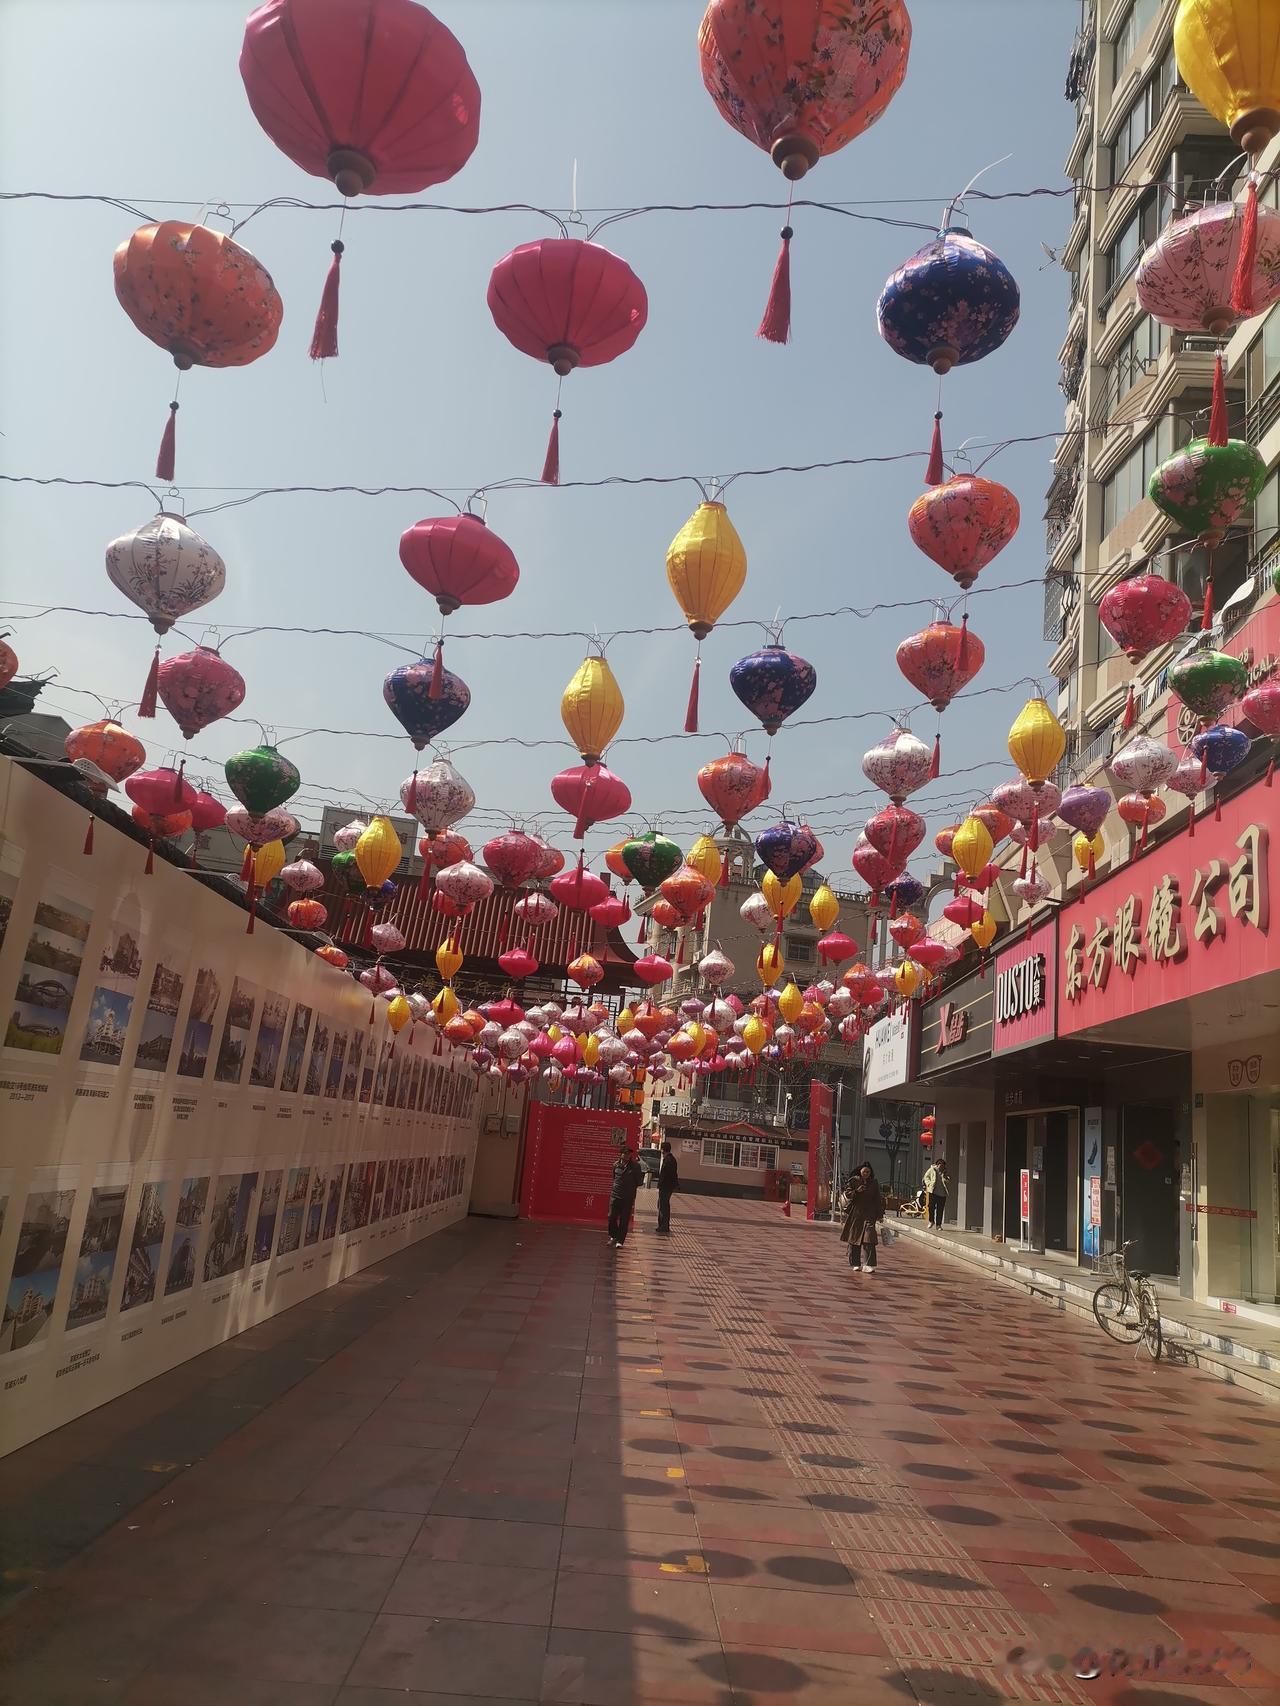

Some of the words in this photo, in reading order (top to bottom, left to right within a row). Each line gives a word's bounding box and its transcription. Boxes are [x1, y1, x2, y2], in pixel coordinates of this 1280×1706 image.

[1064, 824, 1262, 1000] 东方眼镜公司
[997, 956, 1033, 1023] DUSTO
